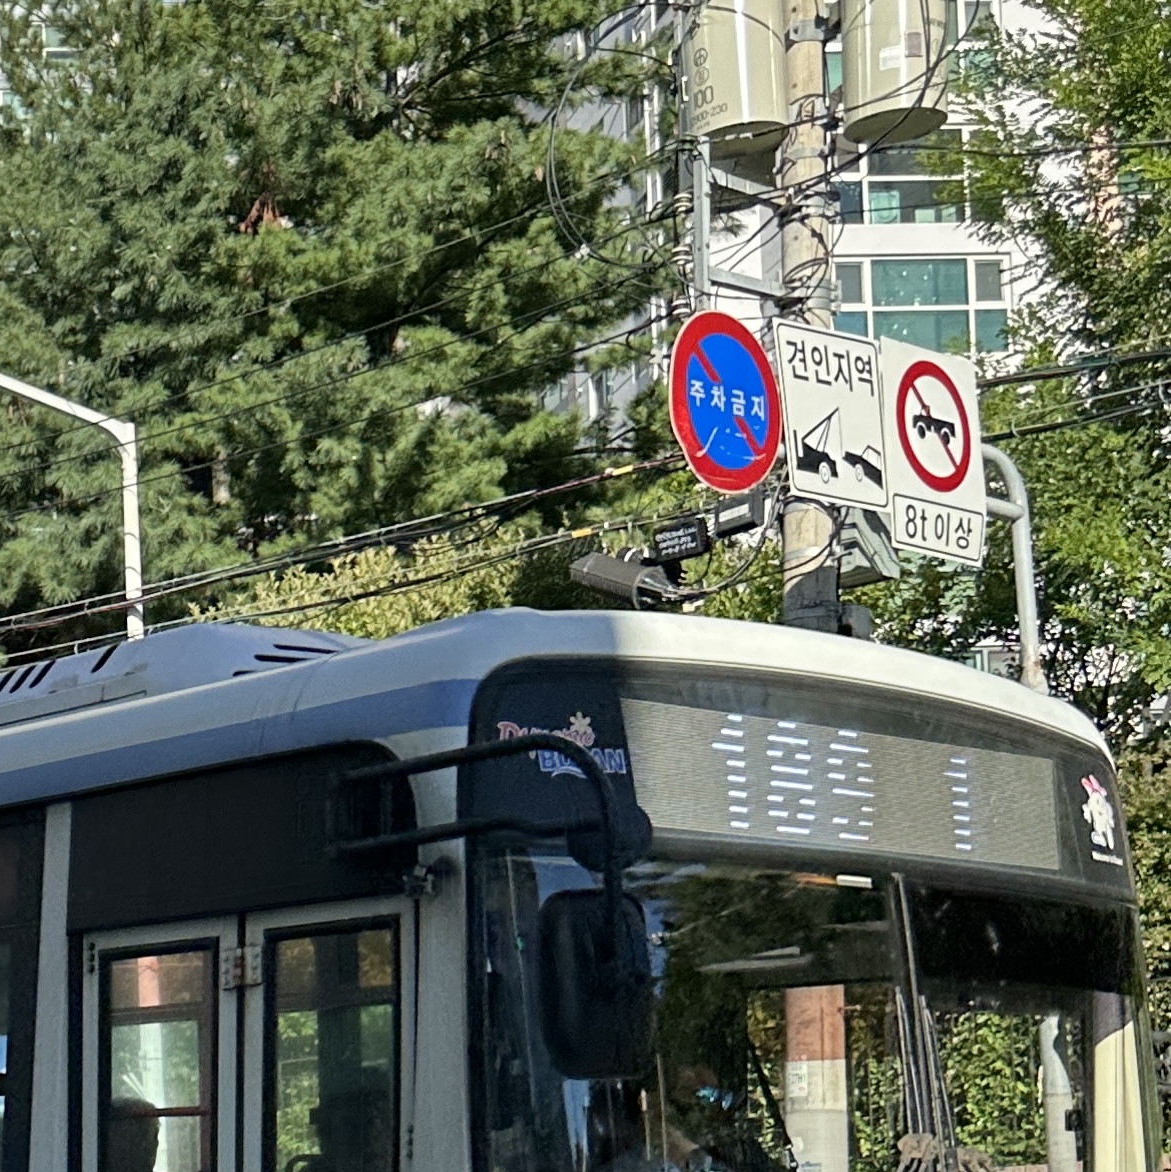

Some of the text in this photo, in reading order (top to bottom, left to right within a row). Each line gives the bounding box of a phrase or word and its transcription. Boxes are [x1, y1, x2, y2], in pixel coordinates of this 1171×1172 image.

[786, 340, 874, 397] 견인지역
[690, 379, 765, 421] 주차금지
[906, 504, 972, 549] 8t 이상
